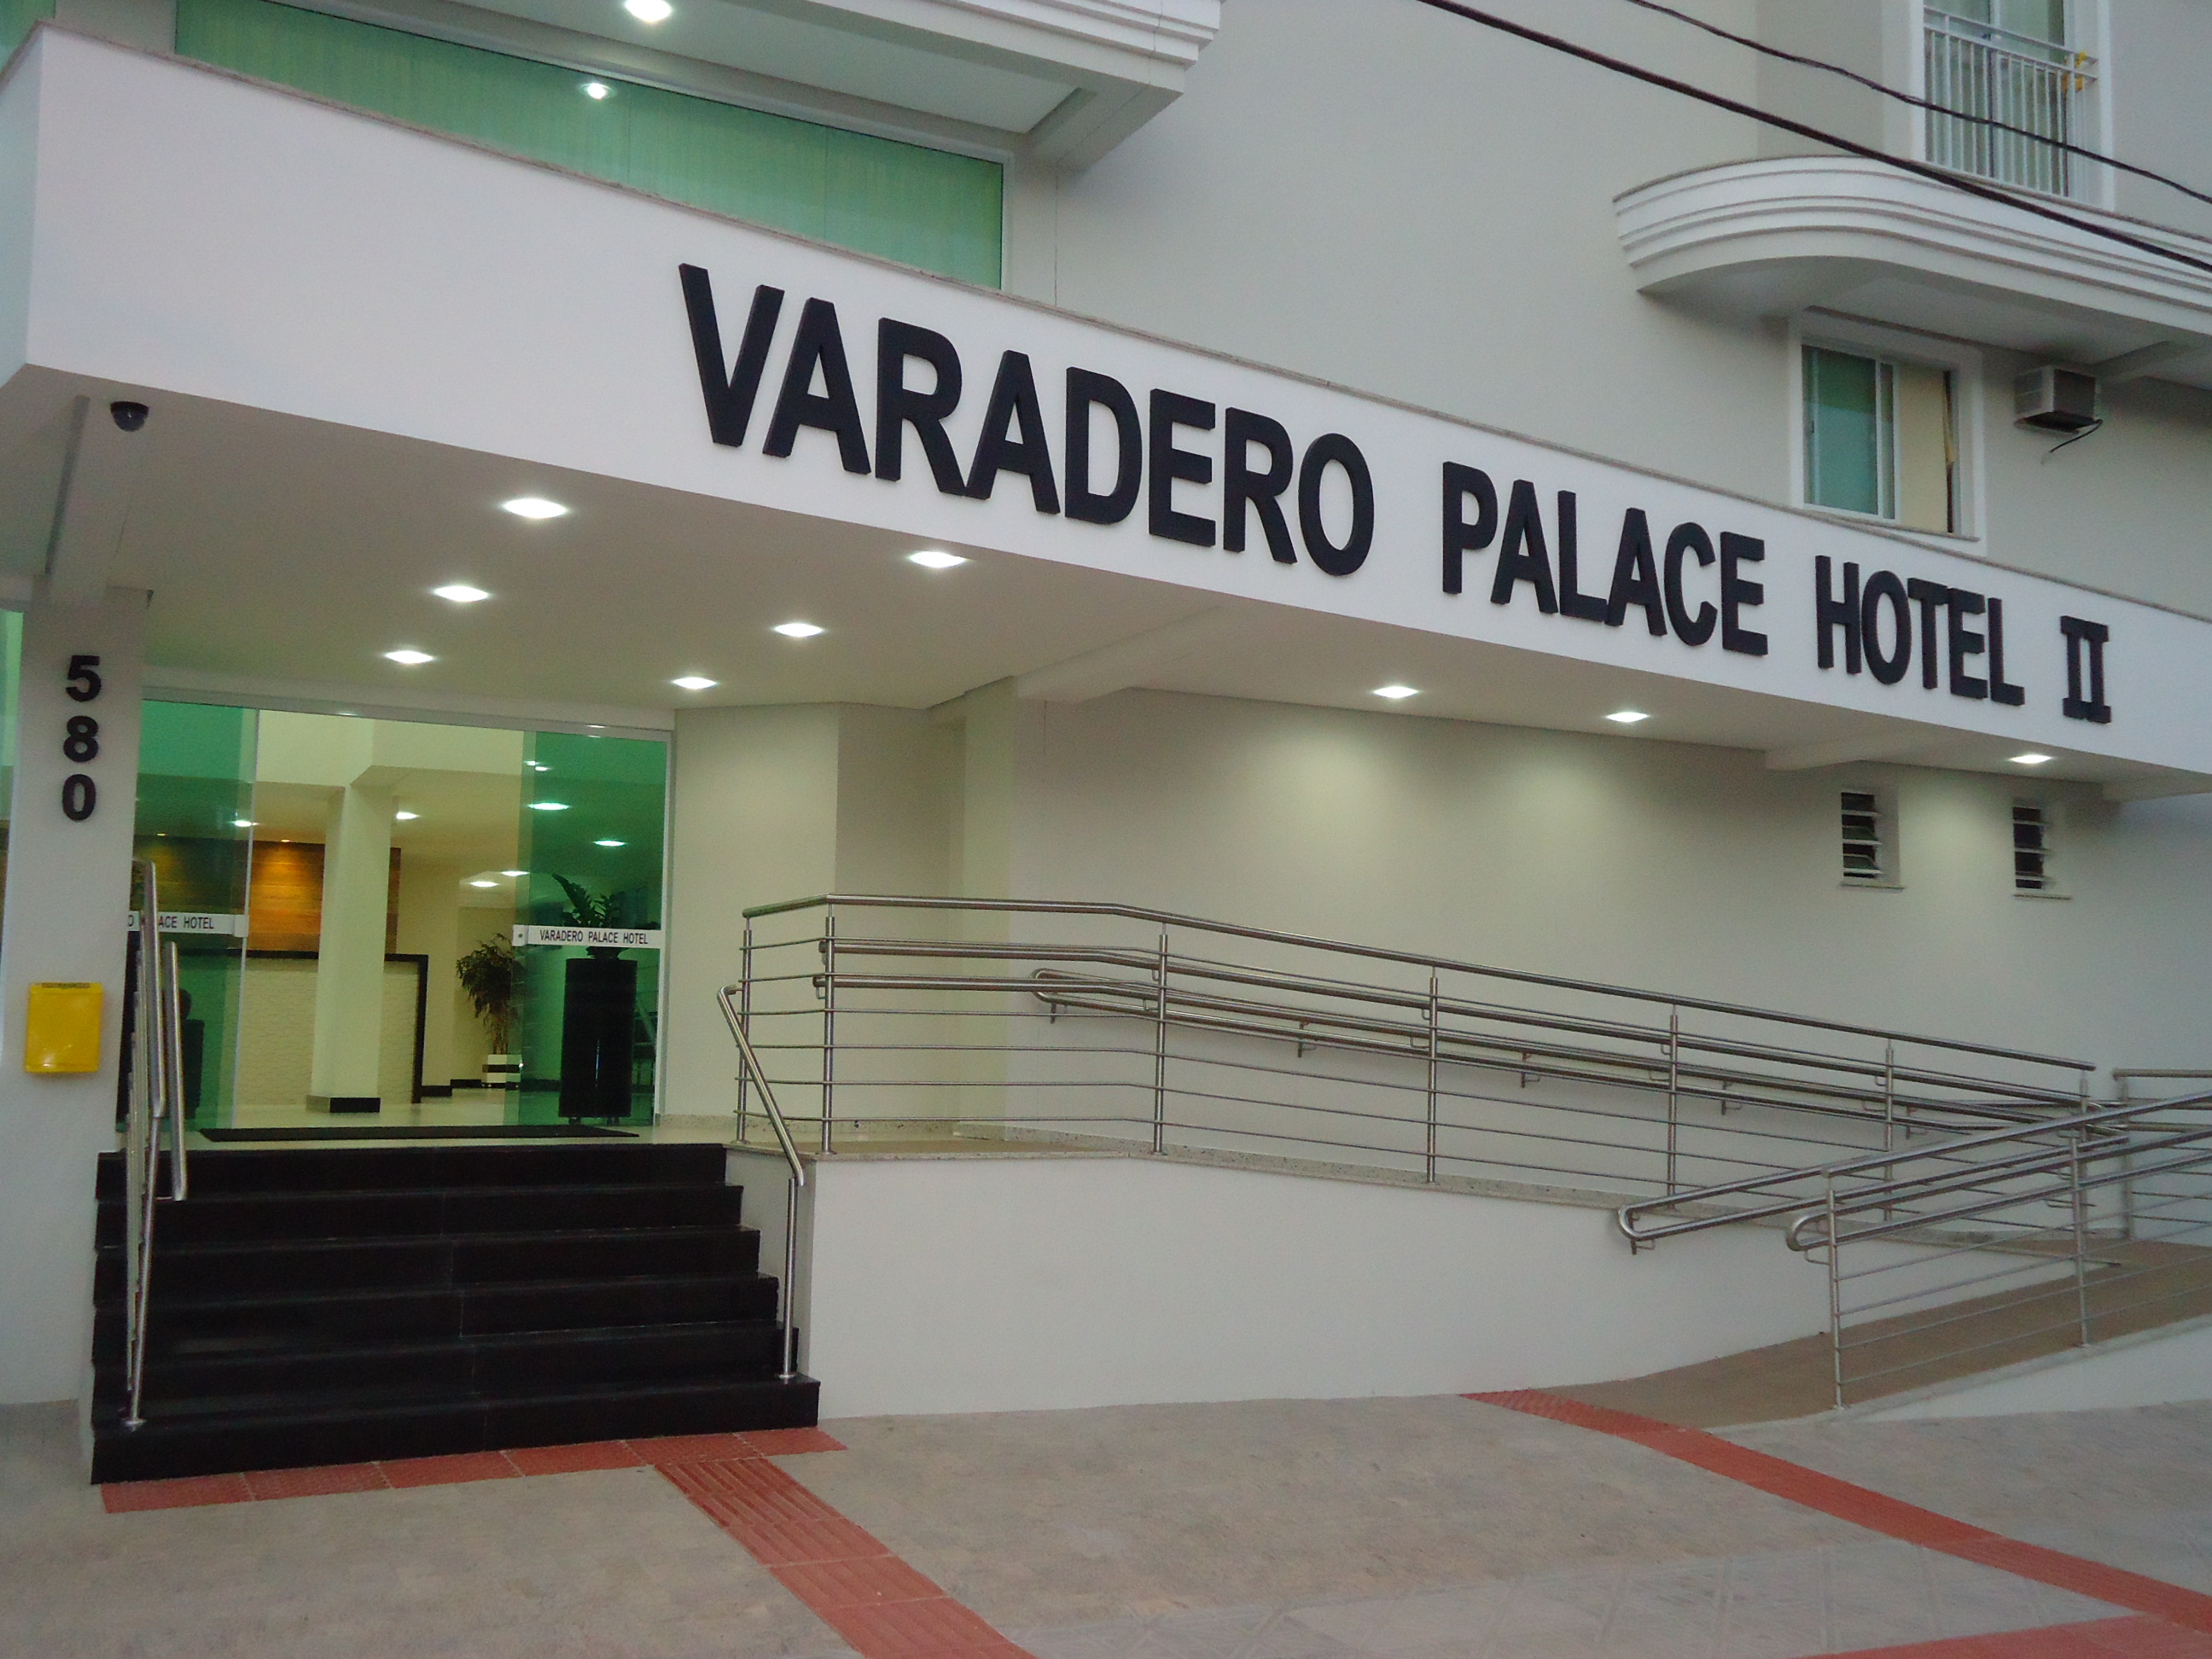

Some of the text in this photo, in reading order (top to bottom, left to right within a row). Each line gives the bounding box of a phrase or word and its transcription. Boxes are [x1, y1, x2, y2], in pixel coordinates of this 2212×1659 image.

[678, 263, 2112, 725] VARADERO PALACE HOTEL II
[183, 916, 214, 929] HOTEL
[539, 929, 649, 945] VARADERO PALACE HOTEL
